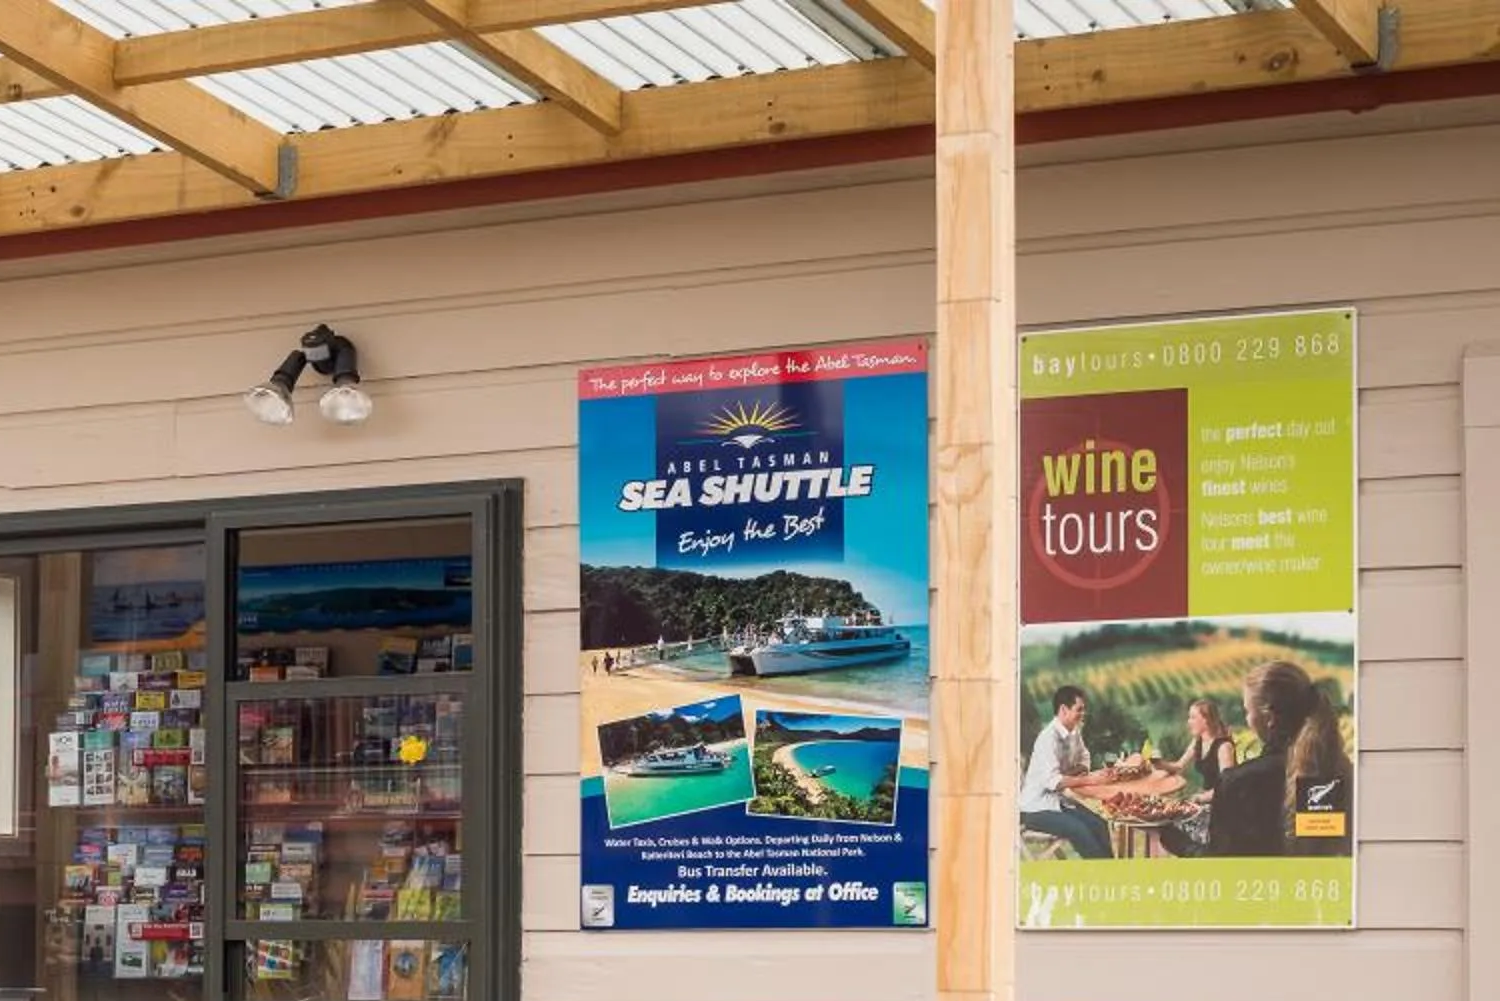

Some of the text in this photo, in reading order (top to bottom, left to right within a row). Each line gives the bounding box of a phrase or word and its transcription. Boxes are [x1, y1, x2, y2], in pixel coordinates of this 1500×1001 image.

[1236, 336, 1281, 362] 229
[1294, 333, 1341, 357] 868
[589, 378, 617, 392] The
[621, 369, 666, 394] perfect
[671, 372, 703, 387] way
[708, 364, 723, 380] to
[729, 361, 781, 385] explore
[785, 357, 811, 373] the
[815, 355, 851, 371] Abel
[1225, 421, 1283, 445] perfect
[667, 450, 831, 475] ABEL TASMAN
[1043, 439, 1158, 498] wine
[617, 464, 875, 512] SEA SHUTTLE
[1202, 479, 1246, 497] finest
[1258, 507, 1293, 525] best
[678, 506, 826, 558] Enjoy the Best
[1043, 503, 1160, 556] tours
[1231, 533, 1270, 550] meet
[604, 837, 631, 848] Water
[658, 837, 690, 847] Cruises
[692, 835, 700, 846] &
[765, 835, 810, 846] Departing
[811, 834, 835, 846] Daily
[835, 833, 859, 843] from
[860, 833, 893, 843] Nelson
[894, 832, 903, 842] &
[715, 849, 724, 859] to
[726, 849, 741, 859] the
[743, 849, 764, 859] Abel
[766, 849, 801, 859] Tasman
[802, 848, 841, 858] National
[677, 863, 829, 878] Bus Transfer Available.
[627, 884, 702, 908] Enquiries
[705, 883, 722, 904] &
[725, 882, 801, 907] Bookings
[804, 883, 826, 903] at
[829, 881, 880, 903] Office
[1235, 879, 1281, 901] 229
[1294, 878, 1341, 901] 868
